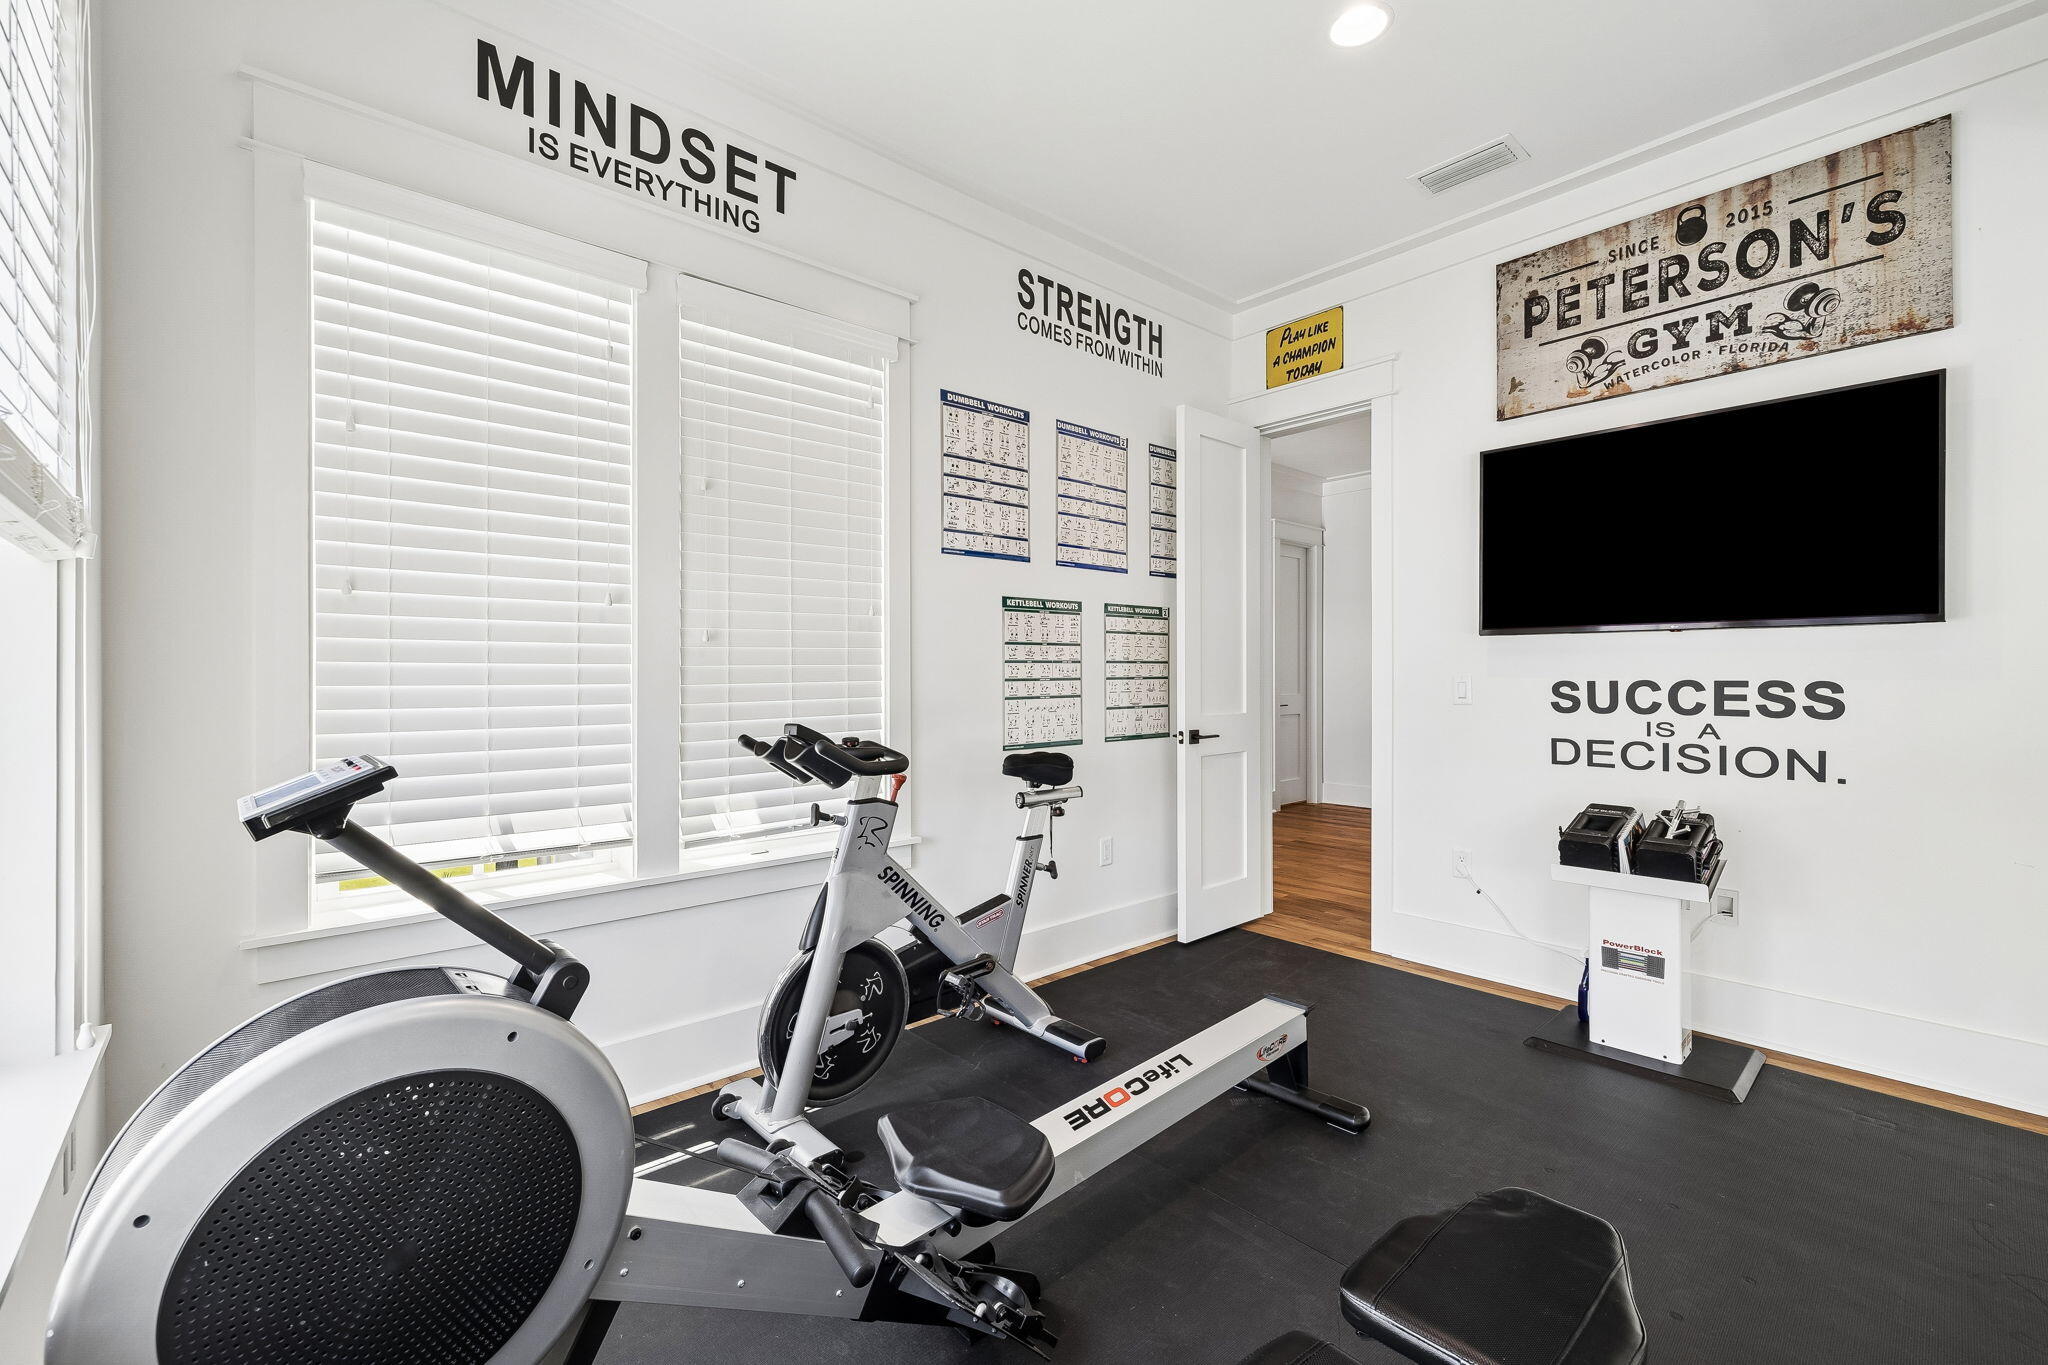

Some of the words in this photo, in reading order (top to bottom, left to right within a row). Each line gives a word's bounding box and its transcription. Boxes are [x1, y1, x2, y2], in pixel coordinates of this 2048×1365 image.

[477, 38, 797, 215] MINDSET
[528, 126, 560, 161] IS
[569, 142, 760, 234] EVERYTHING
[1607, 235, 1660, 265] SINCE
[1725, 200, 1774, 229] 2015
[1523, 189, 1907, 340] PETERSON'S
[1017, 268, 1163, 359] STRENGTH
[1279, 327, 1306, 348] PLAY
[1307, 320, 1330, 337] LIKE
[1627, 301, 1754, 360] GYM
[1017, 312, 1072, 347] COMES
[1076, 332, 1116, 362] FROM
[1118, 347, 1164, 378] WITHIN
[1272, 355, 1281, 368] A
[1282, 336, 1337, 365] CHAMPION
[1603, 349, 1701, 391] WATERCOLOR
[1718, 340, 1790, 356] FLORIDA
[1286, 360, 1323, 382] TODAY
[947, 392, 986, 409] DUMBBELL
[987, 402, 1025, 419] WORKOUTS
[1057, 421, 1088, 435] DUMBBELL
[1089, 430, 1120, 444] WORKOUTS
[1150, 445, 1176, 457] DUMBBELL
[1006, 598, 1044, 608] KETTLEBELL
[1045, 601, 1079, 610] WORKOUTS
[1107, 605, 1133, 613] KETTLEBELL
[1550, 679, 1846, 721] SUCCESS
[1646, 721, 1676, 738] IS
[1697, 723, 1721, 740] A
[1551, 737, 1847, 785] DECISION.
[877, 865, 946, 931] SPINNING
[1016, 858, 1032, 909] SPINNER
[1602, 939, 1663, 956] PowerBlock
[1063, 1053, 1193, 1132] LifeCORE
